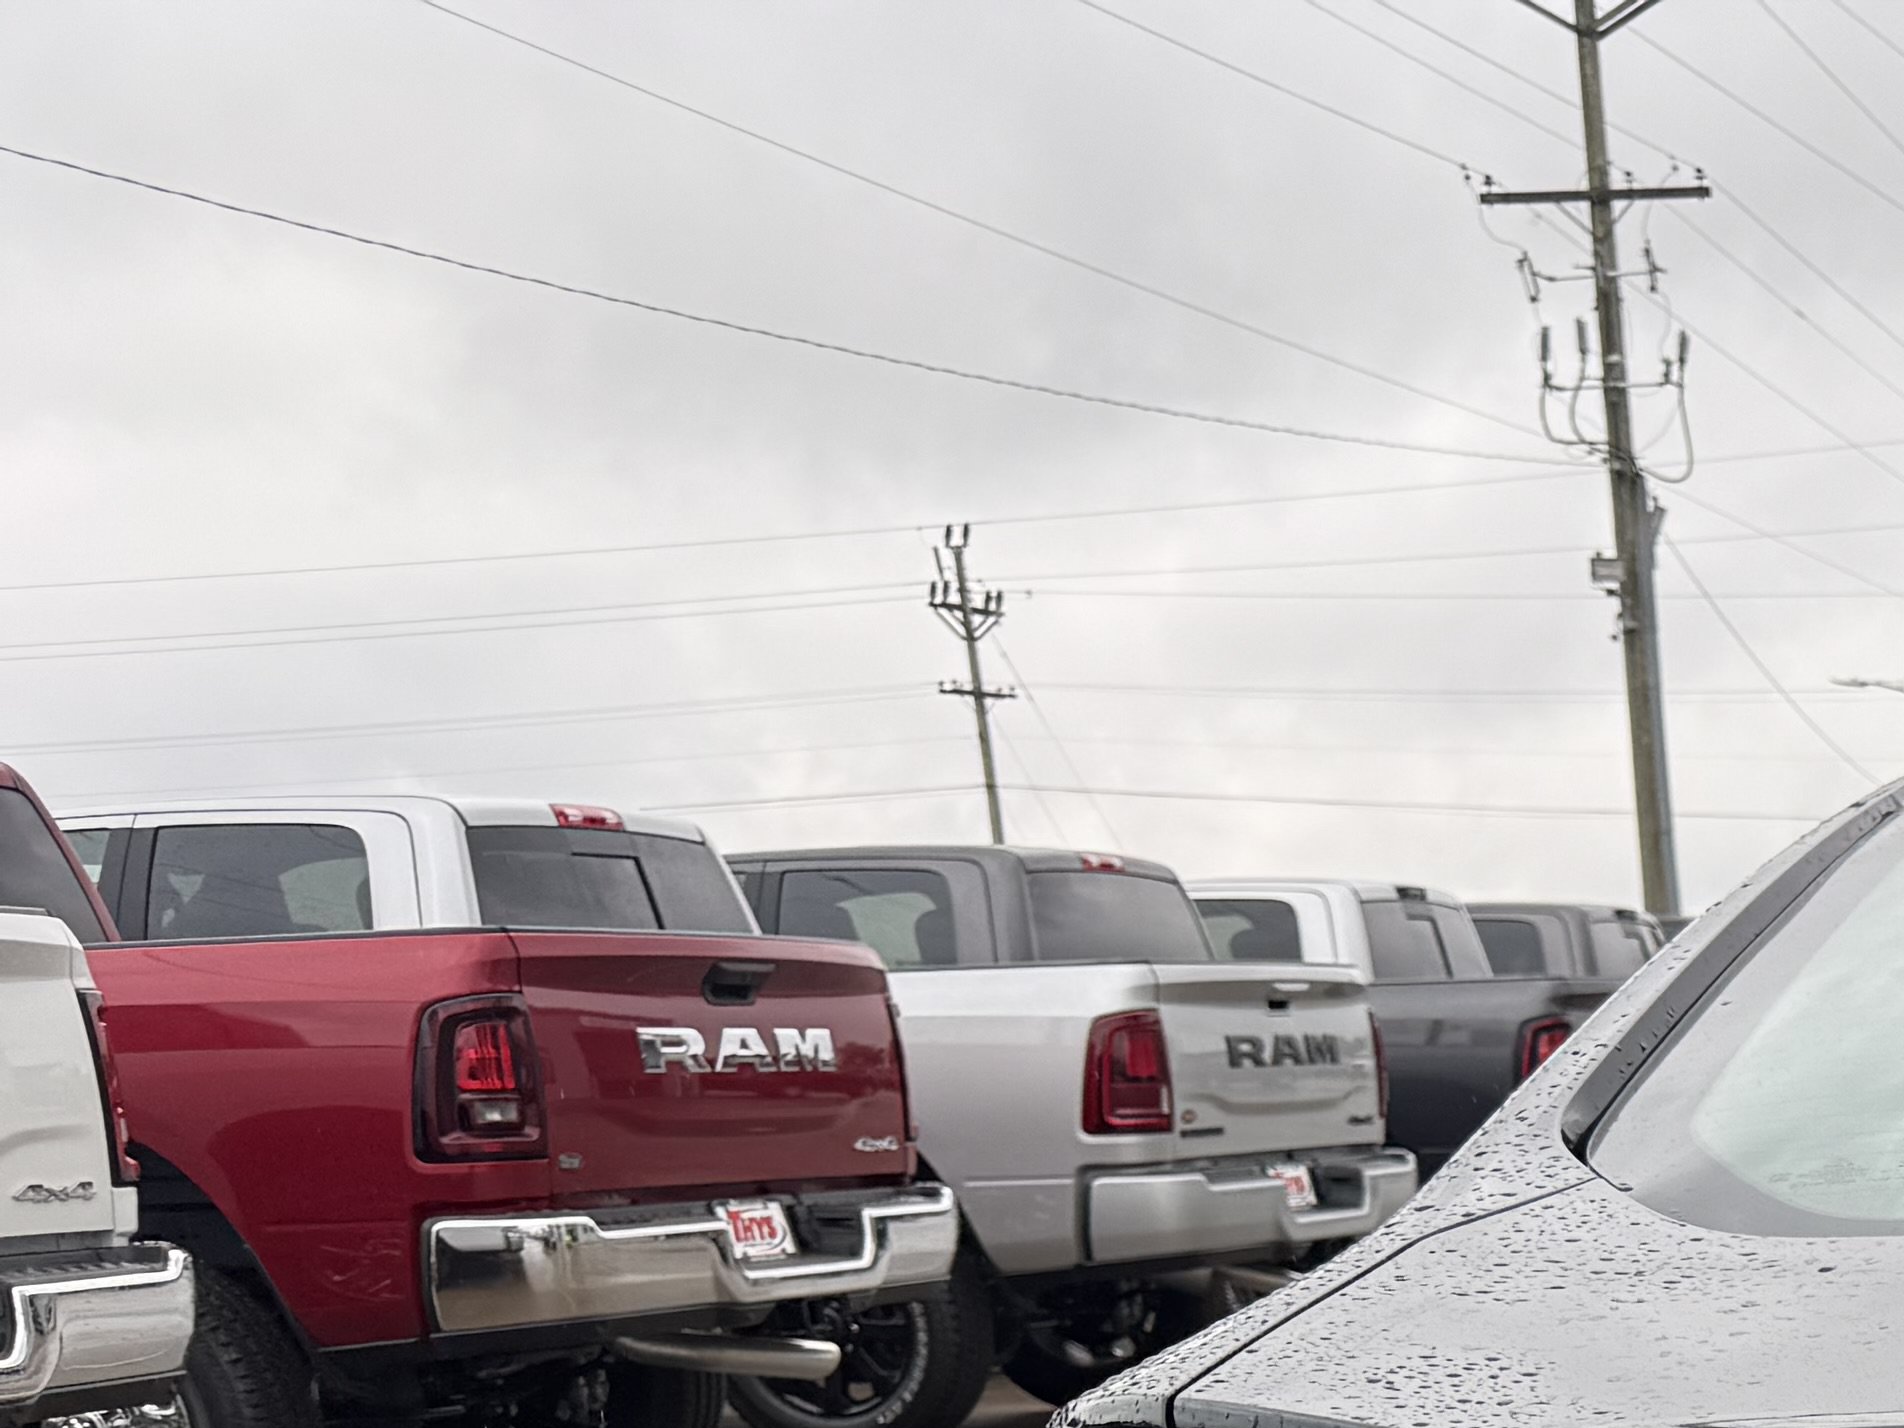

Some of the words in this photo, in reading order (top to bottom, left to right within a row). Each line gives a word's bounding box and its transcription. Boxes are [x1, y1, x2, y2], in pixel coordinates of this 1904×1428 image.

[636, 1027, 838, 1073] RAM
[1225, 1034, 1341, 1069] RAM
[11, 1181, 97, 1203] 4x4
